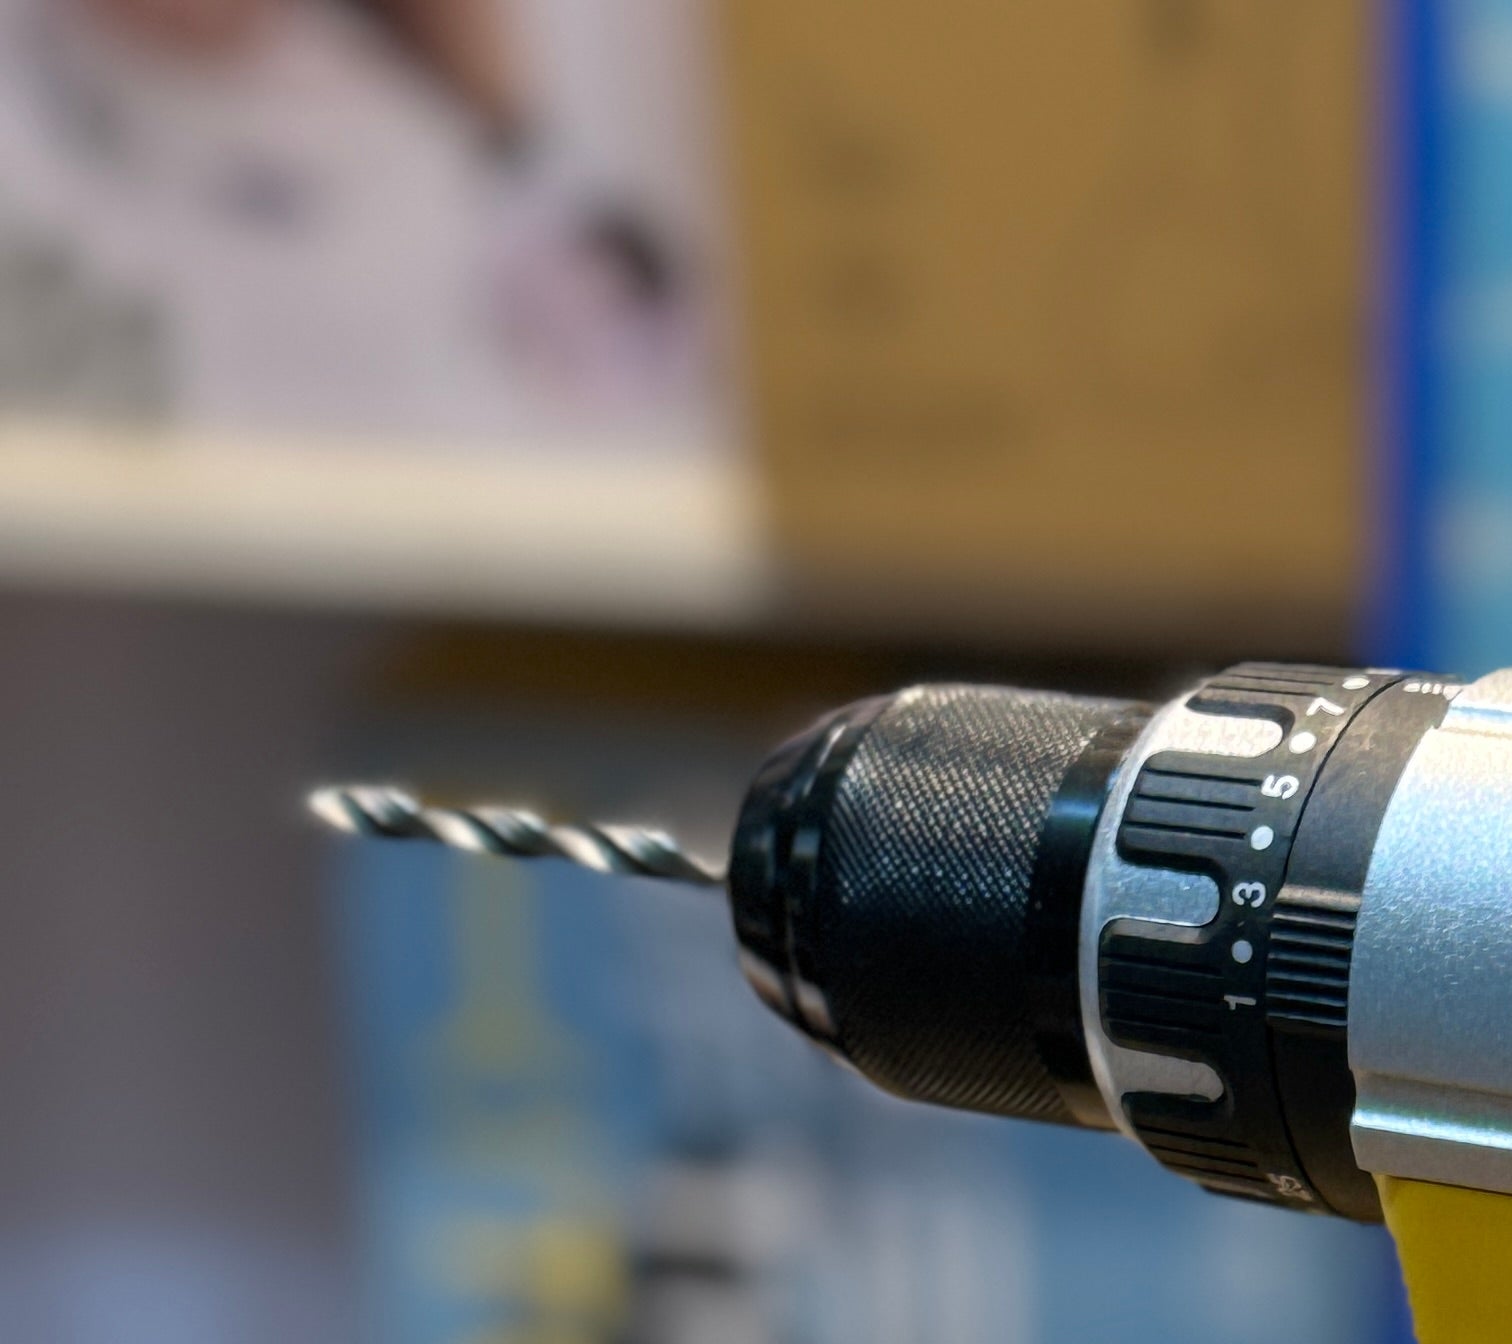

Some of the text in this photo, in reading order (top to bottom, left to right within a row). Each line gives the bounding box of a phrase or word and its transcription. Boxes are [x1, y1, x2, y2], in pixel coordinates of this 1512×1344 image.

[1261, 774, 1300, 800] 5
[1232, 881, 1267, 909] 3
[1223, 993, 1258, 1010] 1
